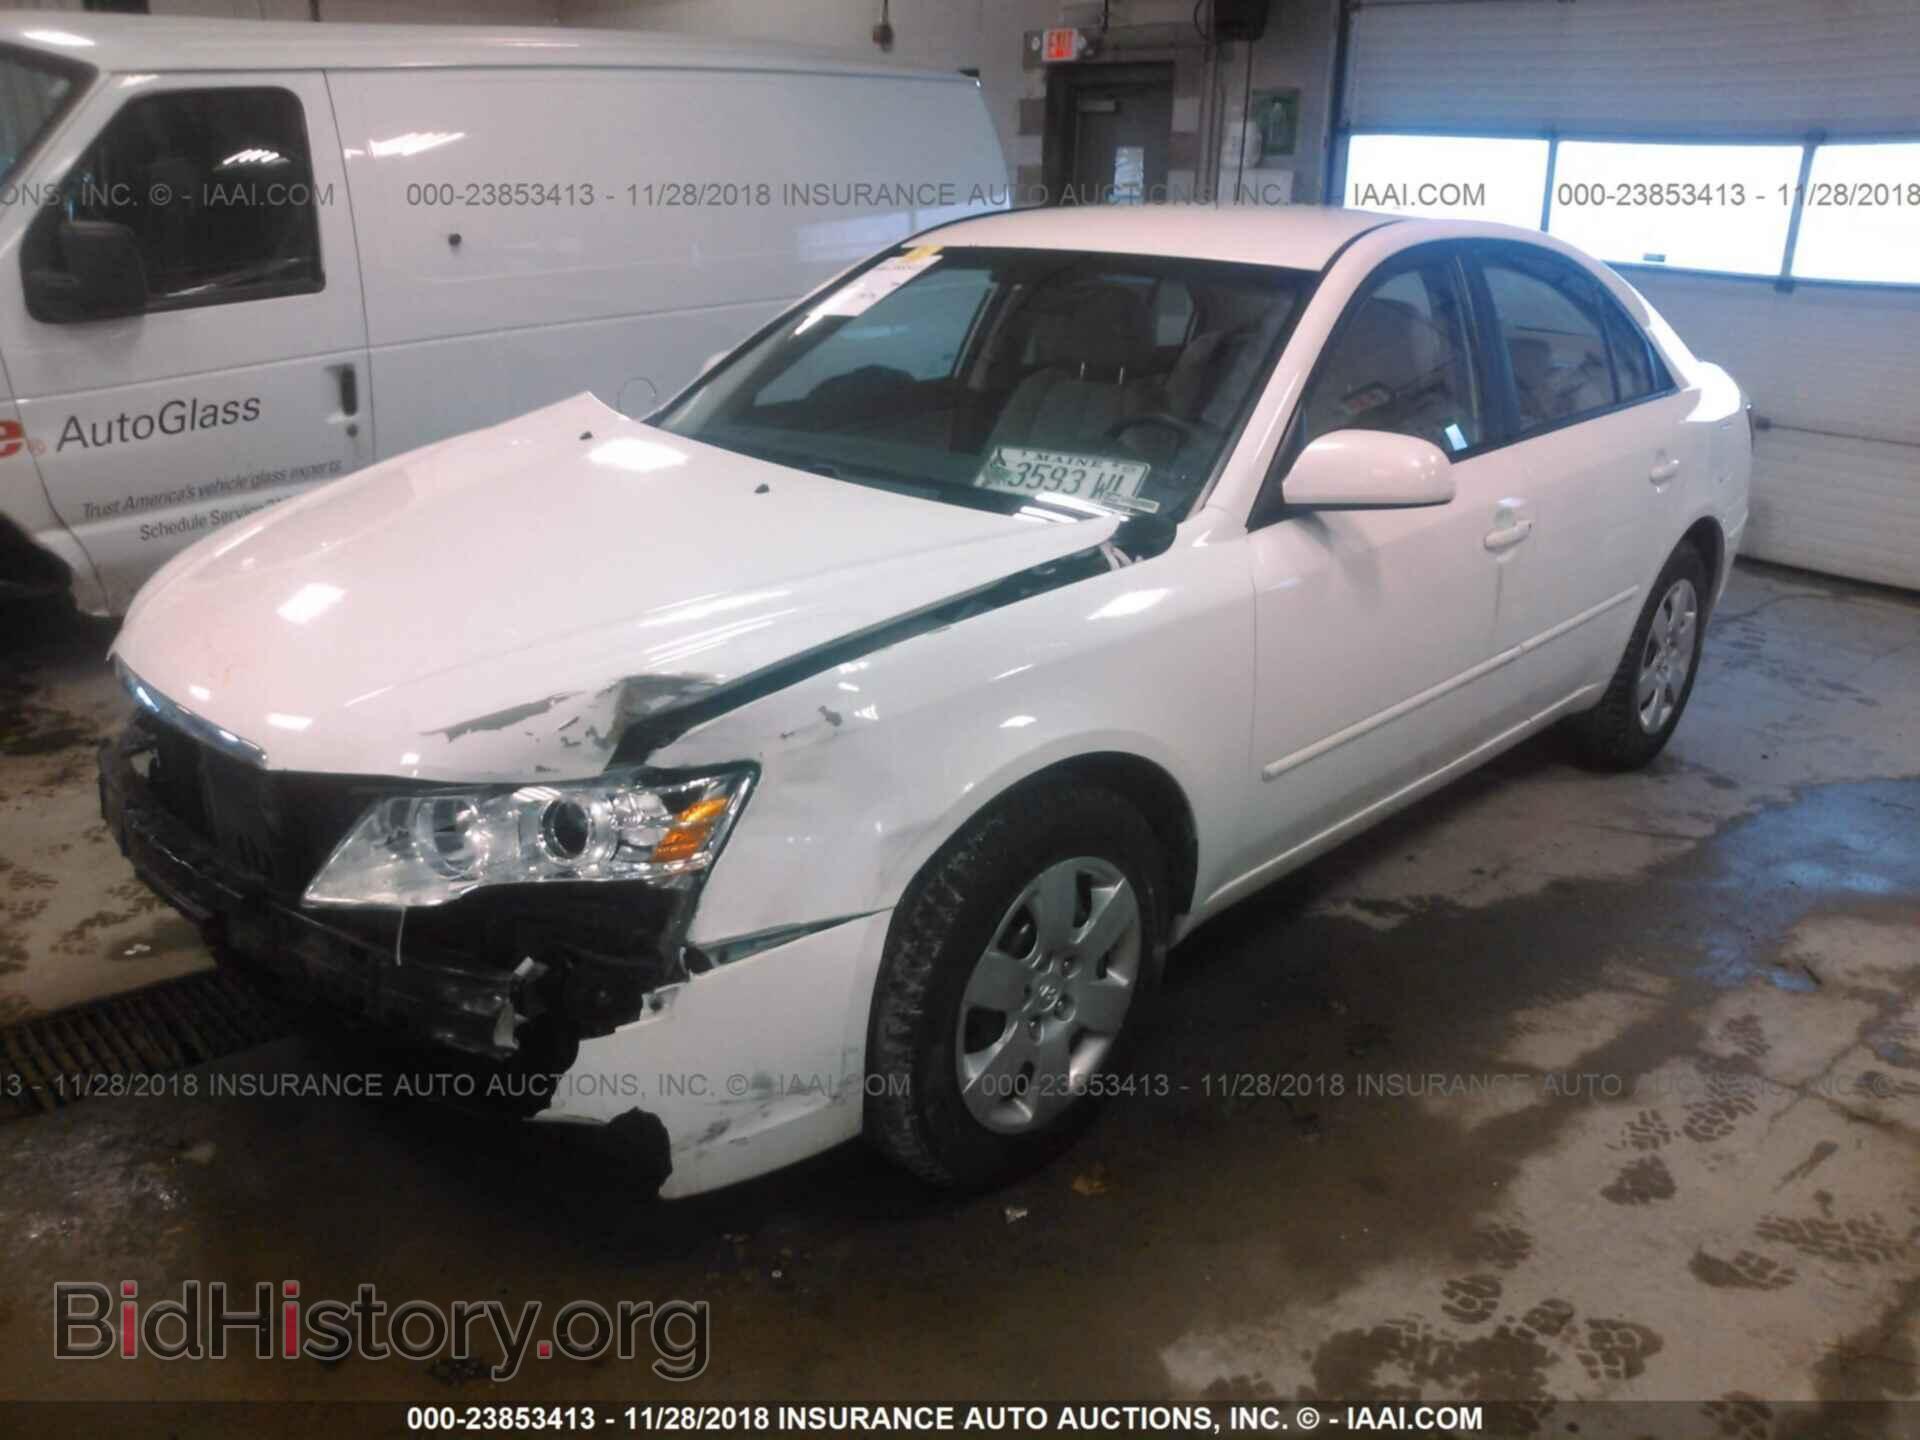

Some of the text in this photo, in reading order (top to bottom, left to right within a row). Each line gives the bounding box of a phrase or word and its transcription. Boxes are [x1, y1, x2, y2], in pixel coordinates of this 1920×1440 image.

[57, 397, 261, 452] AutoGlass
[1008, 462, 1086, 495] 3593
[1036, 452, 1103, 468] MAINE
[82, 459, 343, 521] Trust America's vehicle glass experts
[138, 502, 264, 542] Schedule Serv
